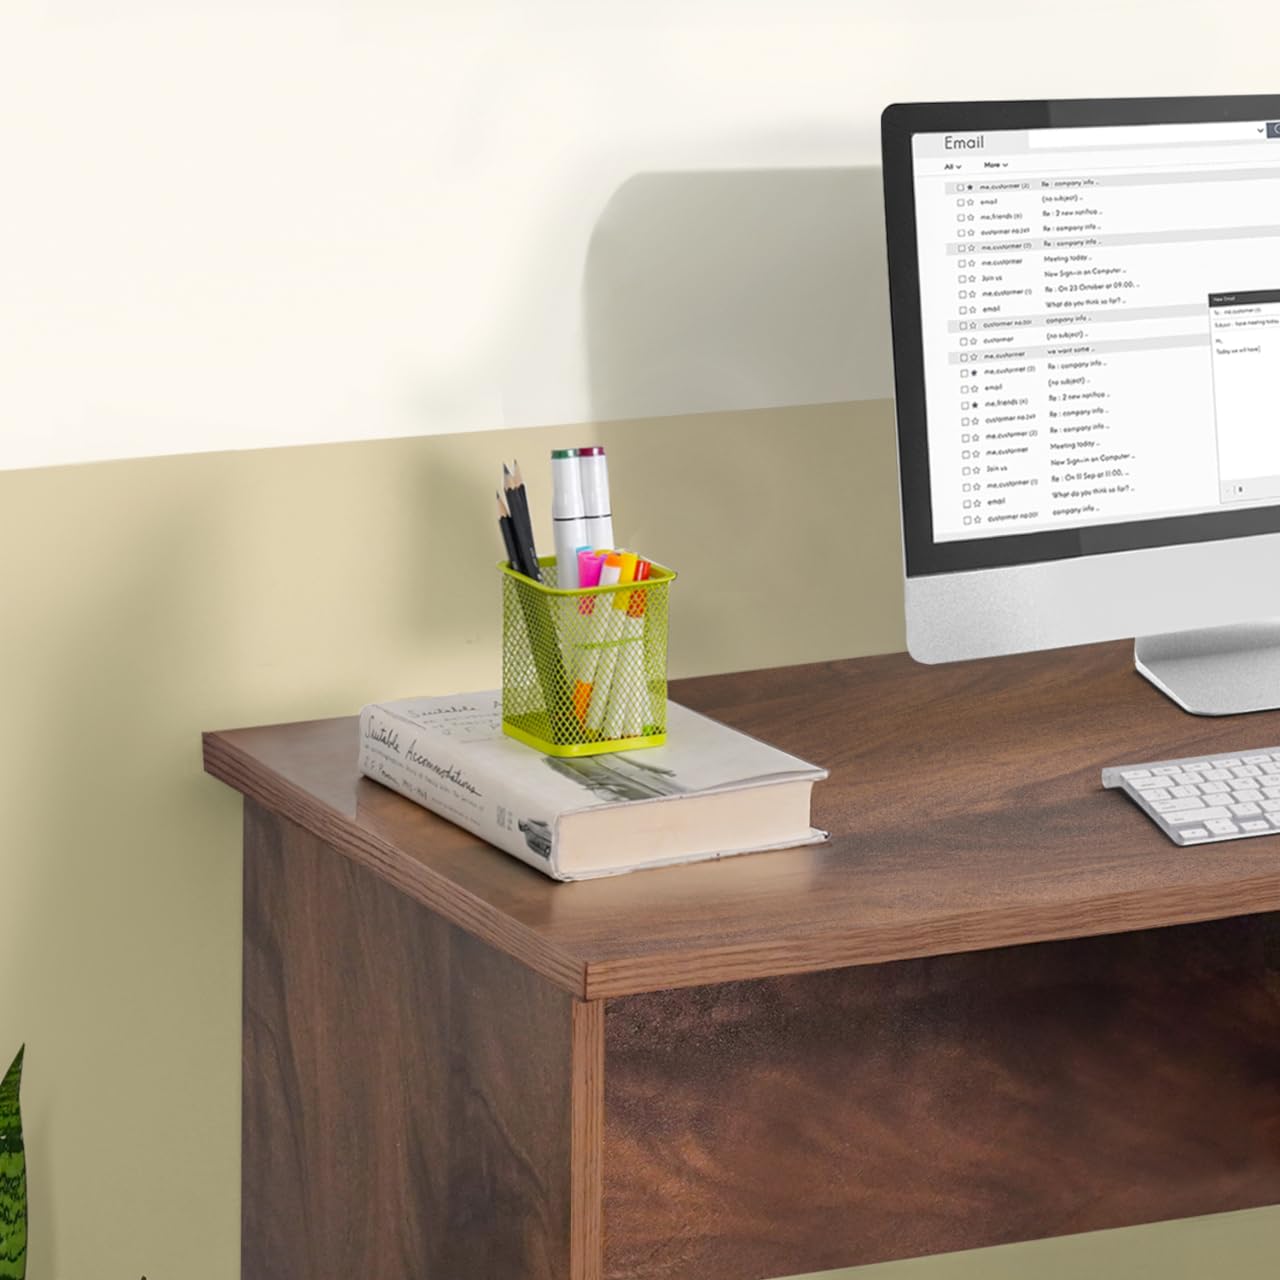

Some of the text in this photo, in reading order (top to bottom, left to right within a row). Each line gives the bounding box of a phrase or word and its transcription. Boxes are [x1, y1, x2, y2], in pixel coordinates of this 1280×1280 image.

[944, 135, 985, 149] Email
[1043, 255, 1069, 263] Meeting
[1091, 267, 1121, 275] Computer
[1057, 284, 1068, 292] On
[1069, 284, 1077, 292] 23
[1078, 283, 1104, 291] October
[1060, 361, 1089, 369] company
[1062, 393, 1067, 401] 2
[1099, 453, 1130, 462] Computer
[1051, 474, 1059, 482] Re
[1064, 473, 1075, 481] On
[1083, 471, 1096, 480] Sep
[1080, 489, 1091, 497] you
[986, 497, 1005, 505] email
[1052, 504, 1094, 515] company info
[365, 714, 401, 755] Suitable
